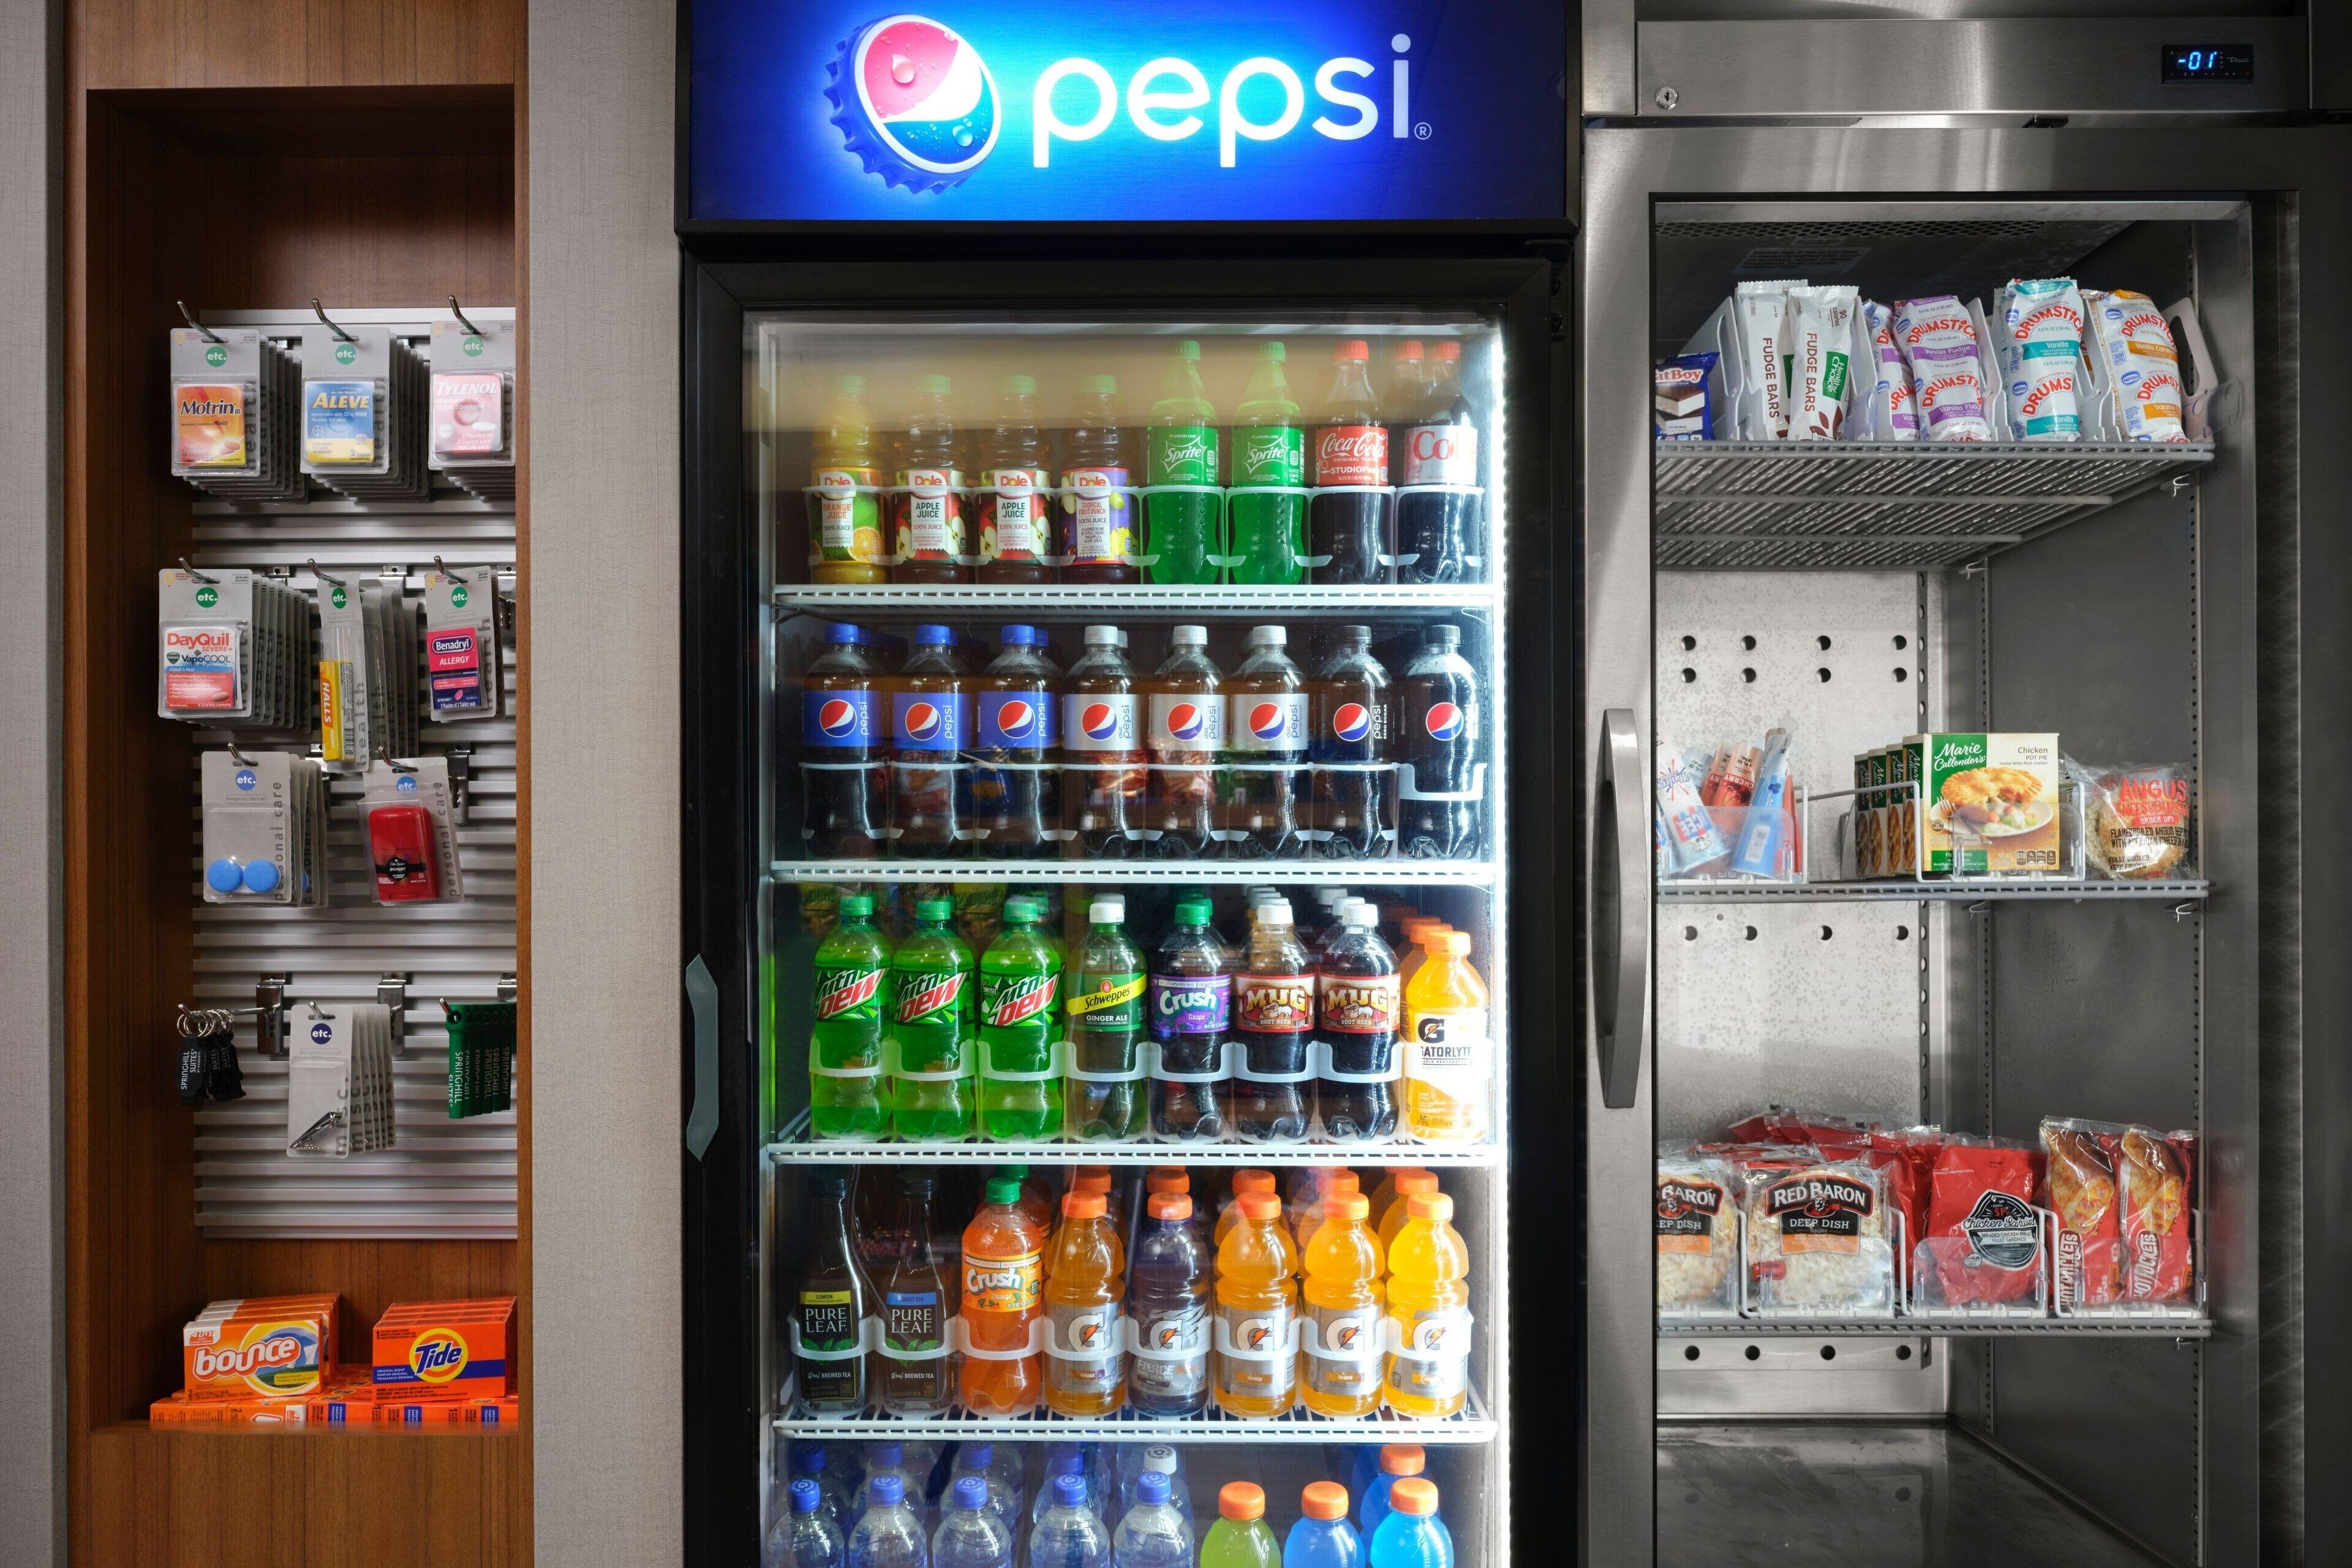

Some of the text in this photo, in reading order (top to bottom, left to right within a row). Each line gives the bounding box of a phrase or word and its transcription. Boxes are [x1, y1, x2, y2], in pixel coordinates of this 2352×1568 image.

[1033, 33, 1411, 168] pepsi
[1839, 309, 1847, 319] 90
[207, 352, 227, 361] etc.
[1924, 345, 1971, 355] Vanilla Fudge
[1656, 369, 1702, 381] atBoy
[1763, 337, 1779, 418] FUDGE BARS
[1804, 333, 1817, 412] FUDGE BARS
[1828, 356, 1839, 393] Choice
[1833, 361, 1844, 393] Healthy
[435, 381, 497, 397] TYLENOL
[181, 399, 235, 415] Motrin
[312, 392, 369, 410] ALEVE
[1939, 402, 1963, 412] Vanilla
[1165, 445, 1202, 462] Sprite
[1248, 446, 1284, 464] Sprite
[1322, 432, 1386, 459] Coca-Cola
[915, 475, 942, 486] Dole
[1000, 475, 1028, 486] Dole
[1079, 476, 1106, 486] Dole
[167, 633, 229, 649] DayQuil
[435, 639, 469, 652] Benadryl
[181, 655, 230, 665] VapoCOOL
[440, 656, 469, 665] ALLERGY
[322, 682, 332, 723] HALLS
[859, 701, 870, 736] pepsi
[943, 705, 954, 739] pepsi
[1036, 703, 1047, 737] pepsi
[1121, 705, 1131, 739] pepsi
[1208, 706, 1218, 739] pepsi
[1290, 704, 1299, 738] pepsi
[1372, 704, 1381, 739] pepsi
[1935, 742, 1982, 759] Marie
[1934, 755, 1986, 771] Callender's
[237, 775, 255, 784] etc.
[1724, 774, 1754, 790] CHERRY
[2119, 777, 2187, 802] ANGUS
[273, 782, 282, 818] care
[434, 782, 446, 816] care
[2155, 826, 2175, 836] ANGUS
[2111, 839, 2127, 848] WITH
[271, 827, 284, 902] personal
[437, 824, 459, 897] personal
[1085, 987, 1131, 1010] Schweppes
[1159, 985, 1217, 1016] Crush
[1247, 989, 1304, 1011] MUG
[1329, 989, 1389, 1011] MUG
[1188, 1013, 1206, 1022] Grape
[312, 1030, 331, 1038] etc.
[1418, 1018, 1445, 1044] G
[181, 1051, 189, 1090] SPRINGHILL
[454, 1052, 463, 1104] SPRINGHILL
[336, 1077, 349, 1155] misc.
[1662, 1185, 1715, 1207] BARON
[1774, 1182, 1866, 1208] RED BARON
[1677, 1220, 1702, 1230] DISH
[1790, 1218, 1849, 1229] DEEP DISH
[1964, 1217, 2002, 1229] Chicken
[966, 1267, 1022, 1292] Crush
[2133, 1276, 2152, 1298] HOT
[805, 1308, 846, 1321] PURE
[892, 1308, 932, 1321] PURE
[806, 1321, 846, 1333] LEAF
[892, 1321, 932, 1333] LEAF
[195, 1338, 296, 1376] bounce
[415, 1340, 462, 1376] Tide
[1137, 1360, 1175, 1375] FIERCE
